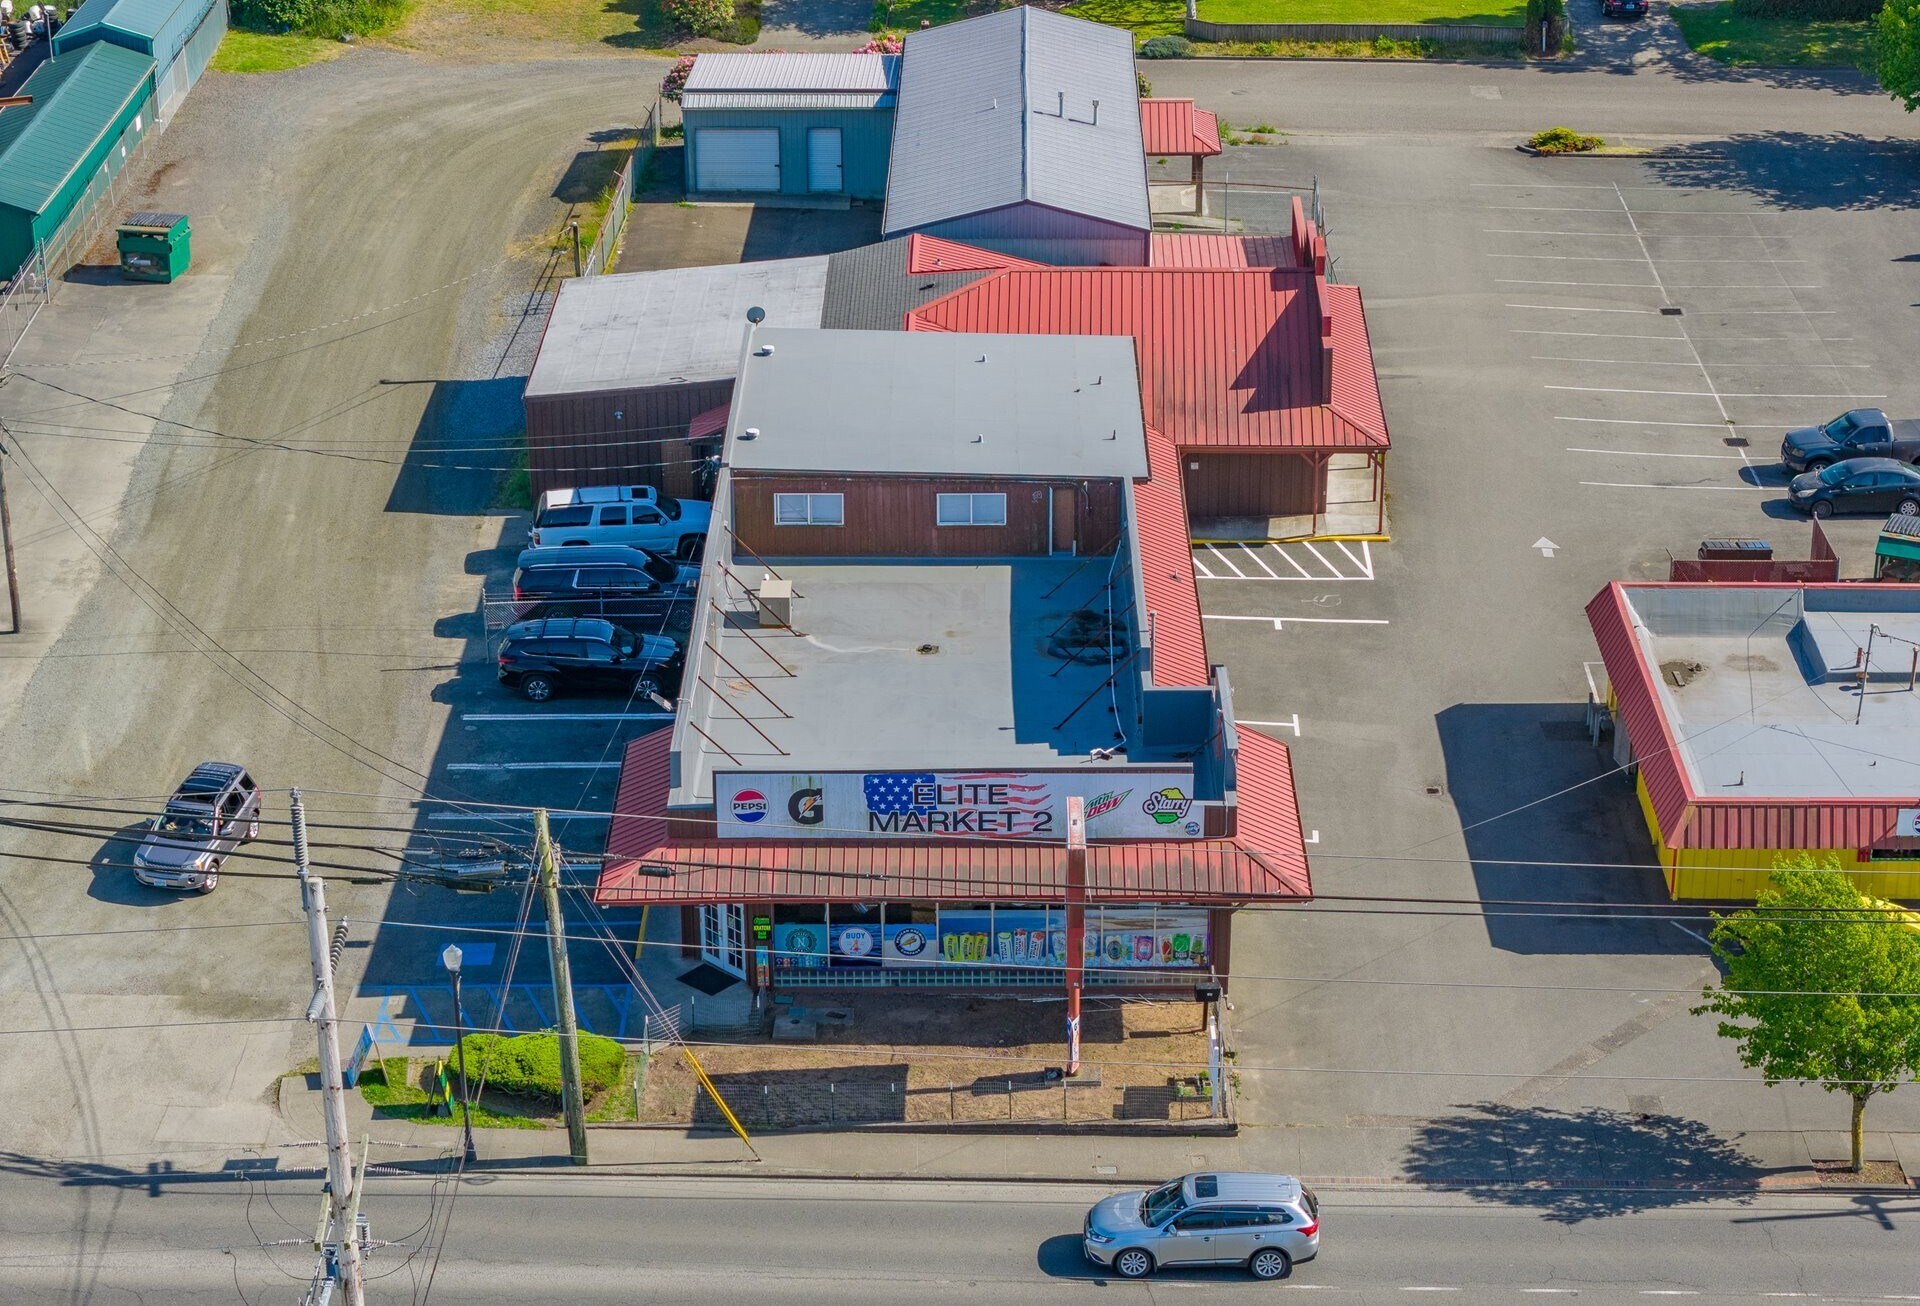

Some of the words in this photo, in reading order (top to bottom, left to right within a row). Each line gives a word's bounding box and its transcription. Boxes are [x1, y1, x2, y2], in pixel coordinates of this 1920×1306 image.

[913, 784, 1008, 805] ELITE
[1142, 790, 1193, 819] Starry
[733, 802, 766, 810] PEPSI
[788, 788, 824, 825] G
[869, 811, 1021, 832] MARKET
[1032, 811, 1052, 832] 2
